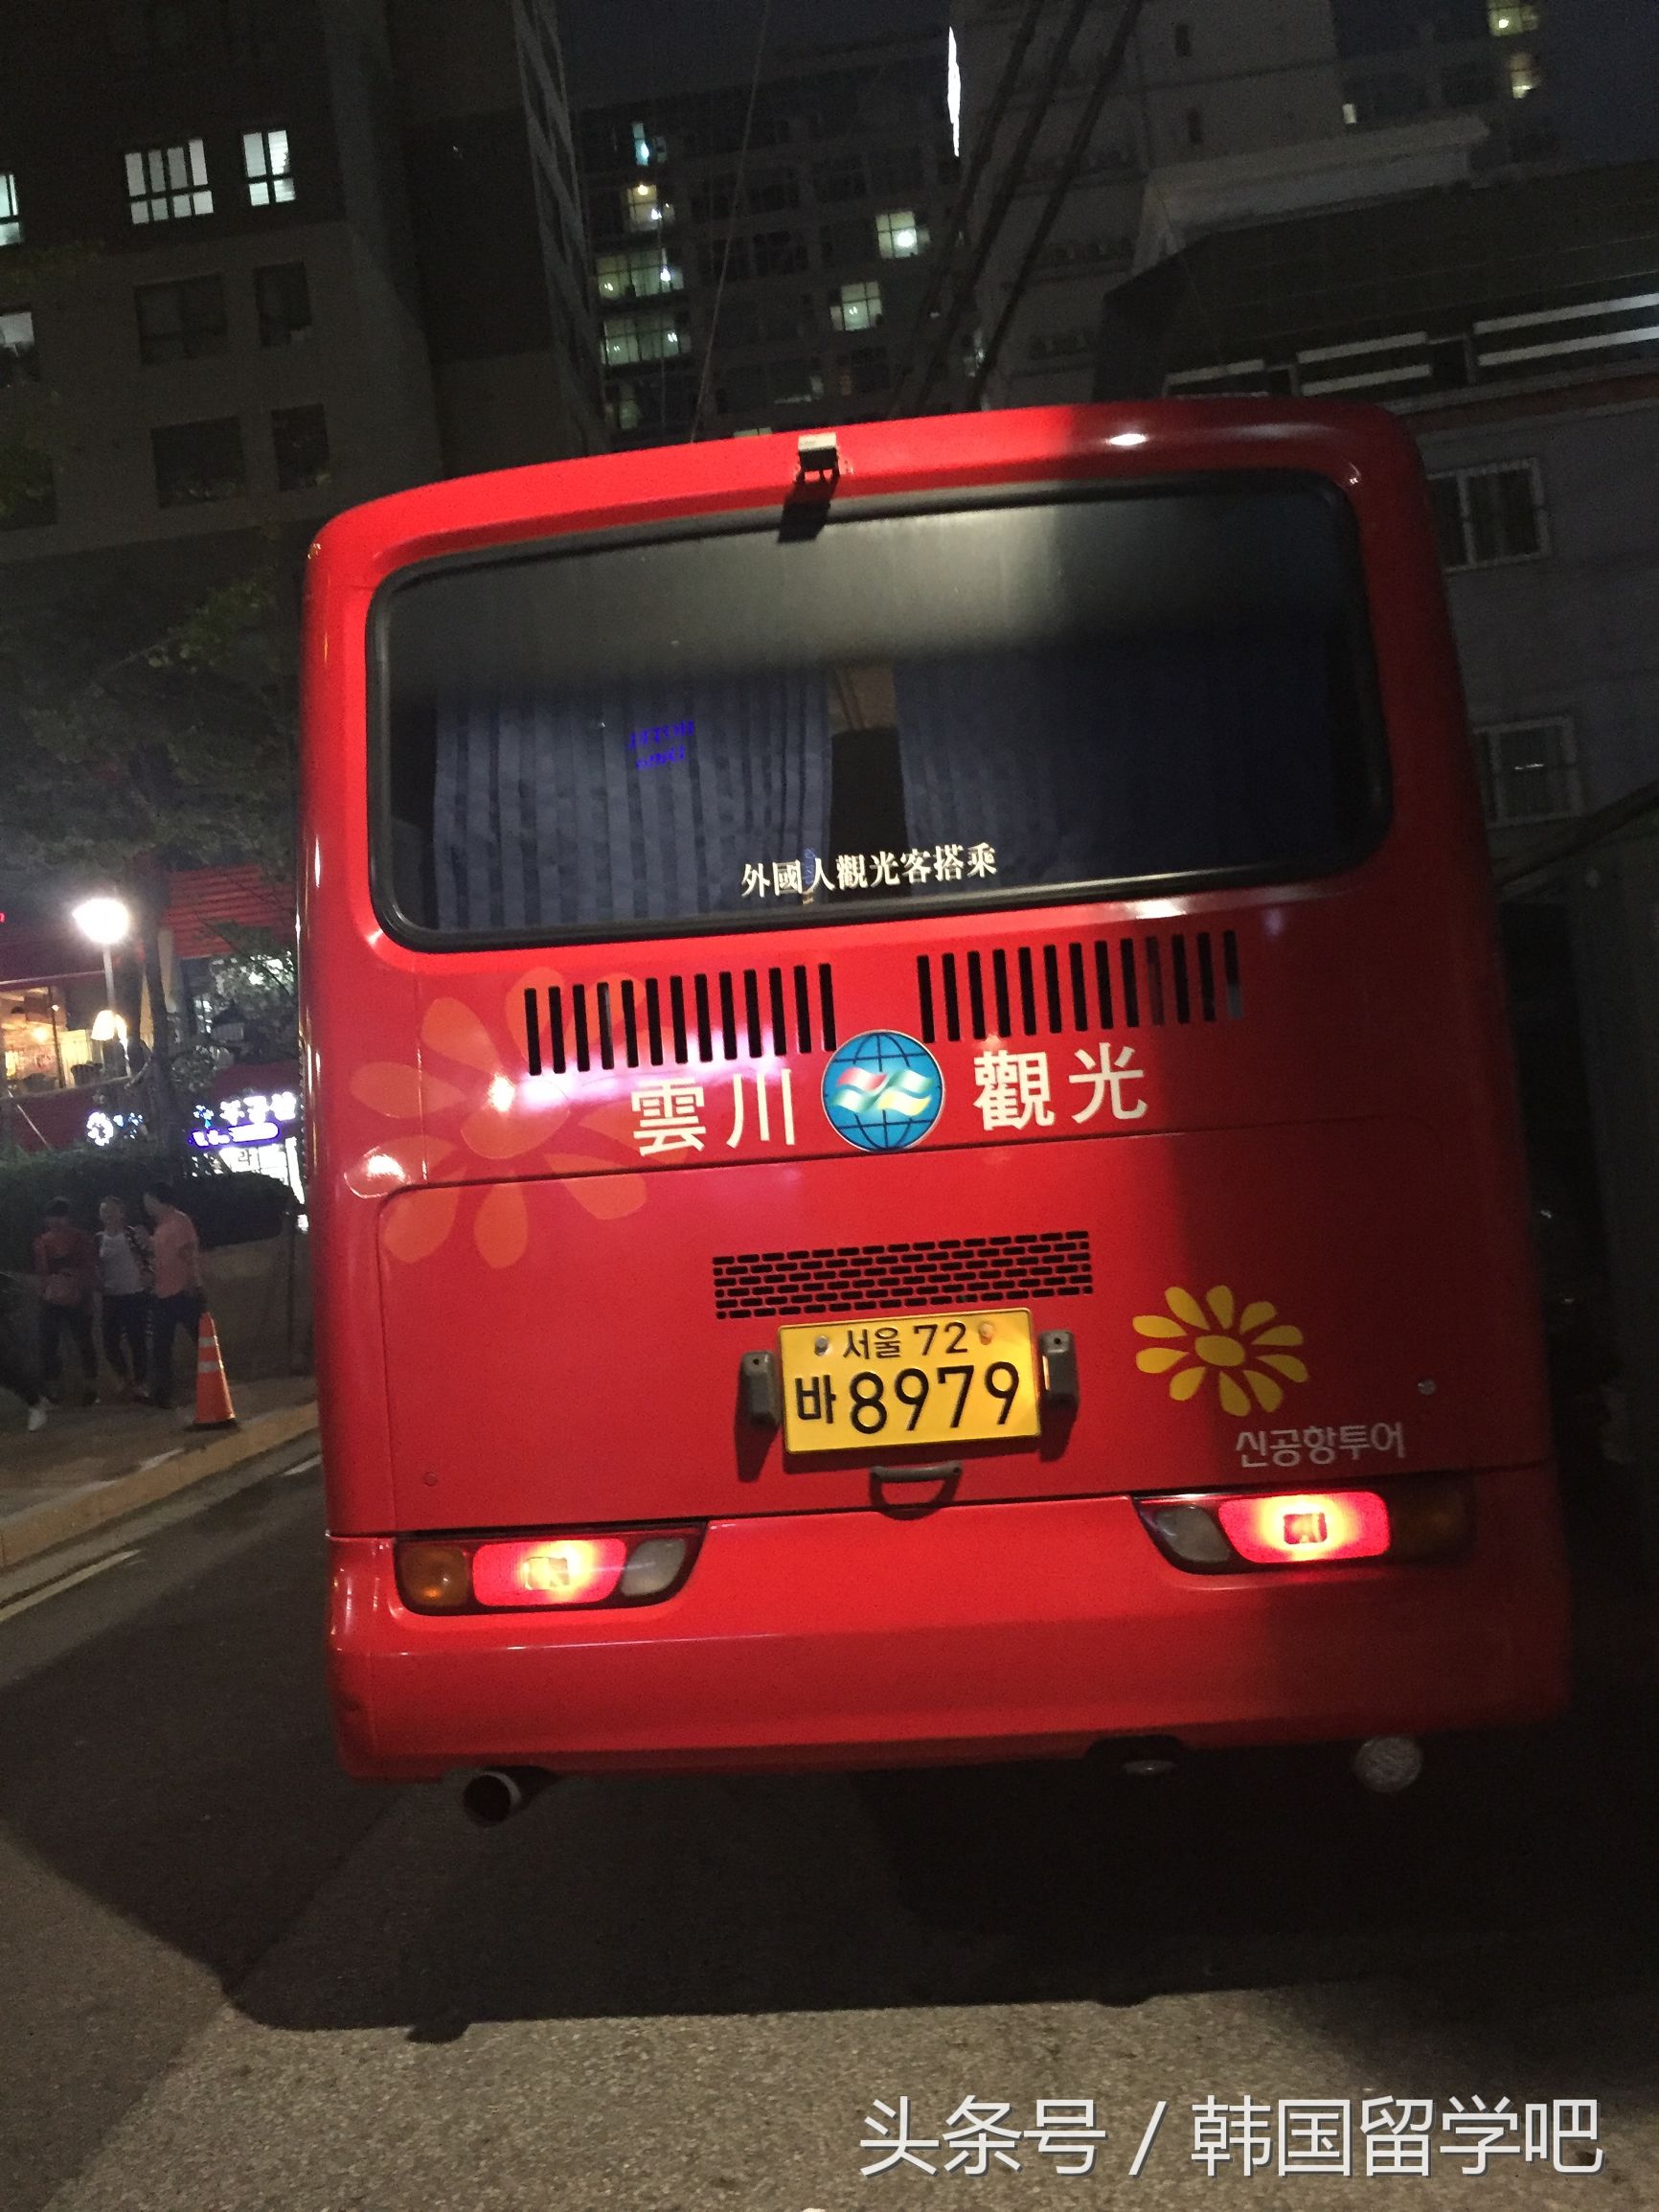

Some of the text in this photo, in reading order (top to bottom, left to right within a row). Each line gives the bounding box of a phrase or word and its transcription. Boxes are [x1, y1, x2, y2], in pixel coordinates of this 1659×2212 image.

[741, 841, 997, 898] 外國人觀光客搭乘
[630, 1041, 1149, 1156] 雲川 觀光
[843, 1321, 968, 1359] 서울 72
[1235, 1421, 1407, 1468] 신공항투어
